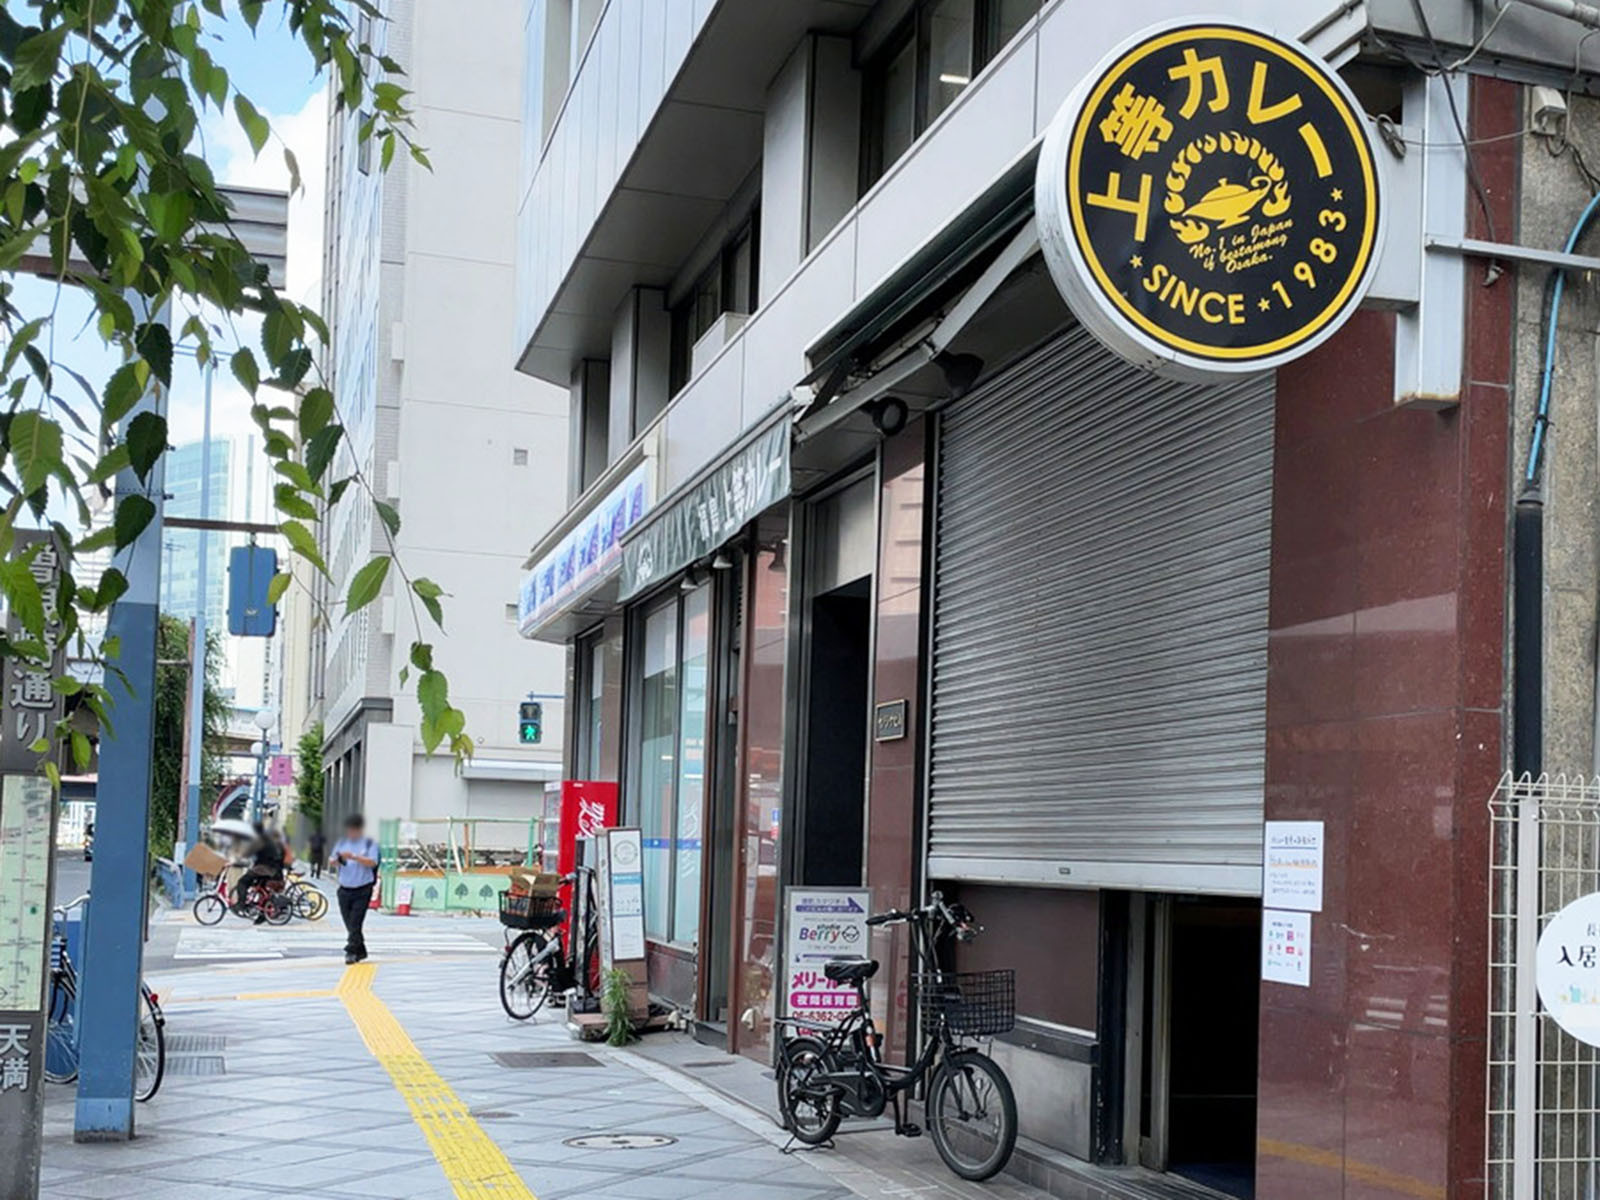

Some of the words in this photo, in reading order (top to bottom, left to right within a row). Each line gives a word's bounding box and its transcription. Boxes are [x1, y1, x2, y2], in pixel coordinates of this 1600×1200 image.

[1087, 48, 1333, 242] 上等カレー
[1251, 219, 1293, 244] Japan
[1143, 264, 1246, 325] SINCE
[1272, 209, 1347, 309] 1983
[799, 926, 841, 944] Berry
[0, 1024, 31, 1091] 天満
